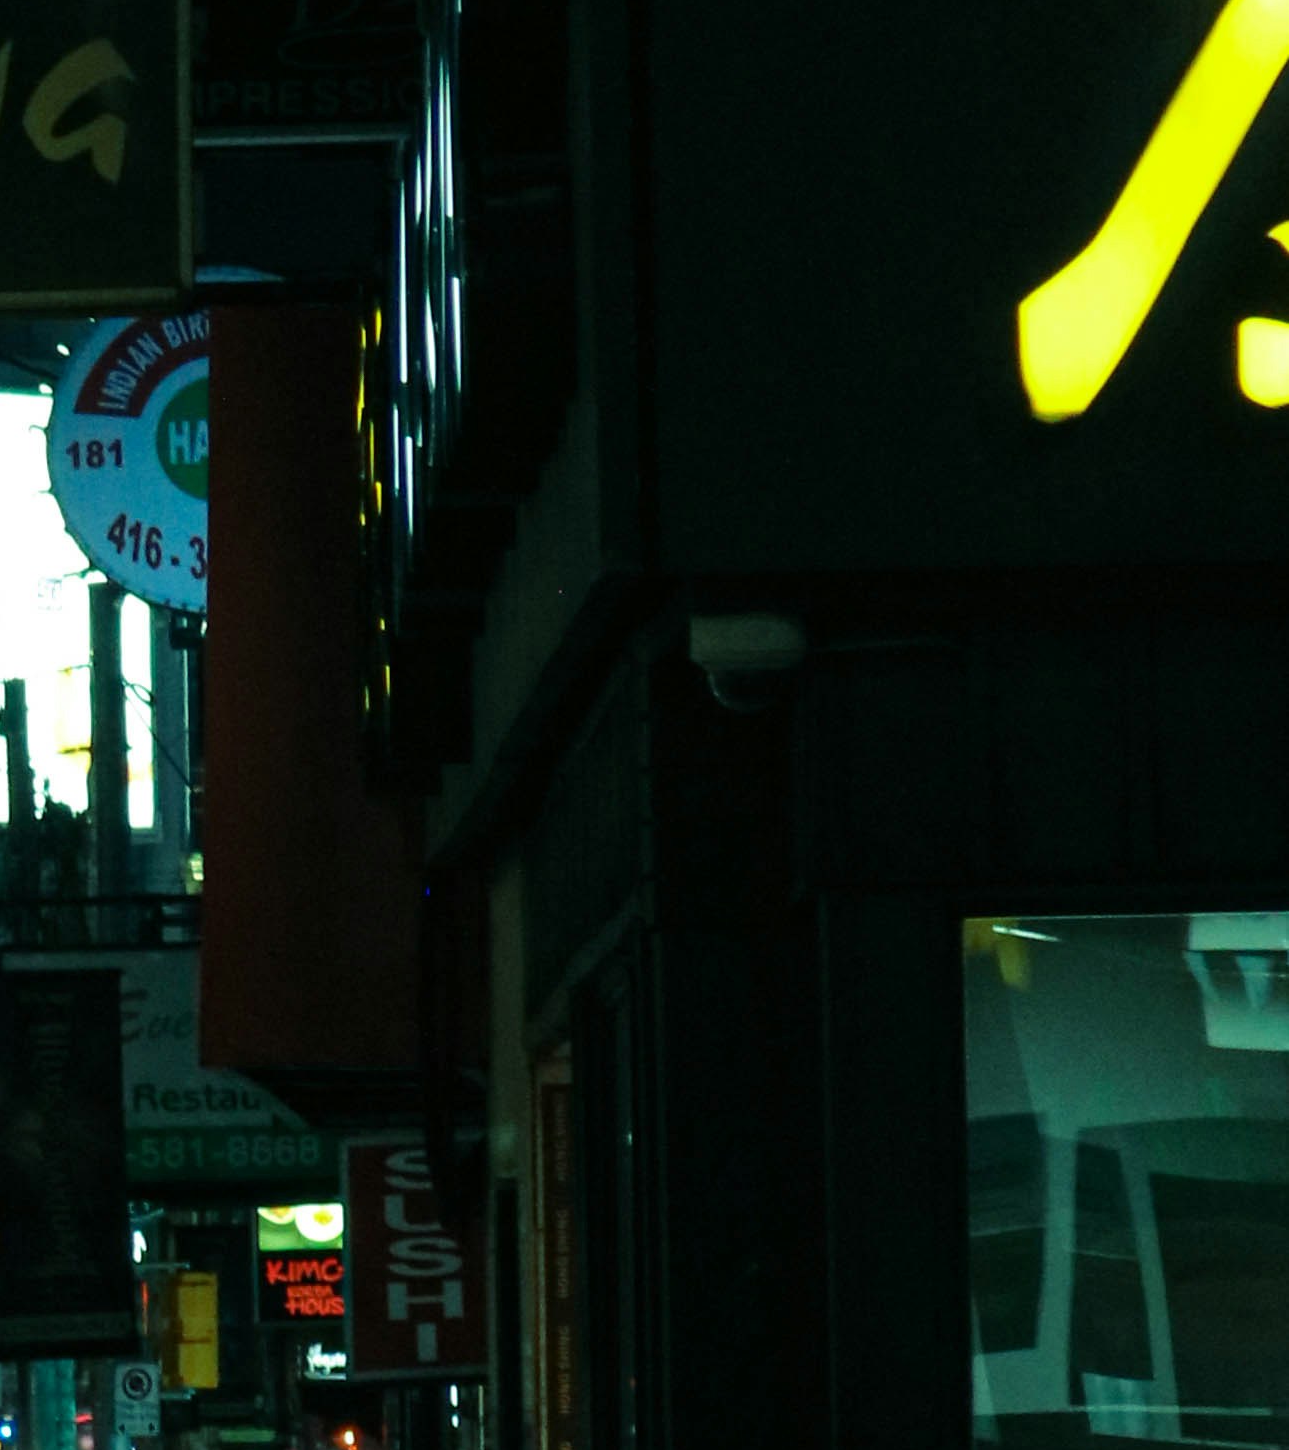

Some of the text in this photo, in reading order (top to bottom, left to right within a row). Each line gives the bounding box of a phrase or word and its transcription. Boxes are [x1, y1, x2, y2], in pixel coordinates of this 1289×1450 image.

[96, 308, 209, 413] INDIAN BIR
[65, 438, 124, 470] 181
[383, 1149, 464, 1364] SUSHI
